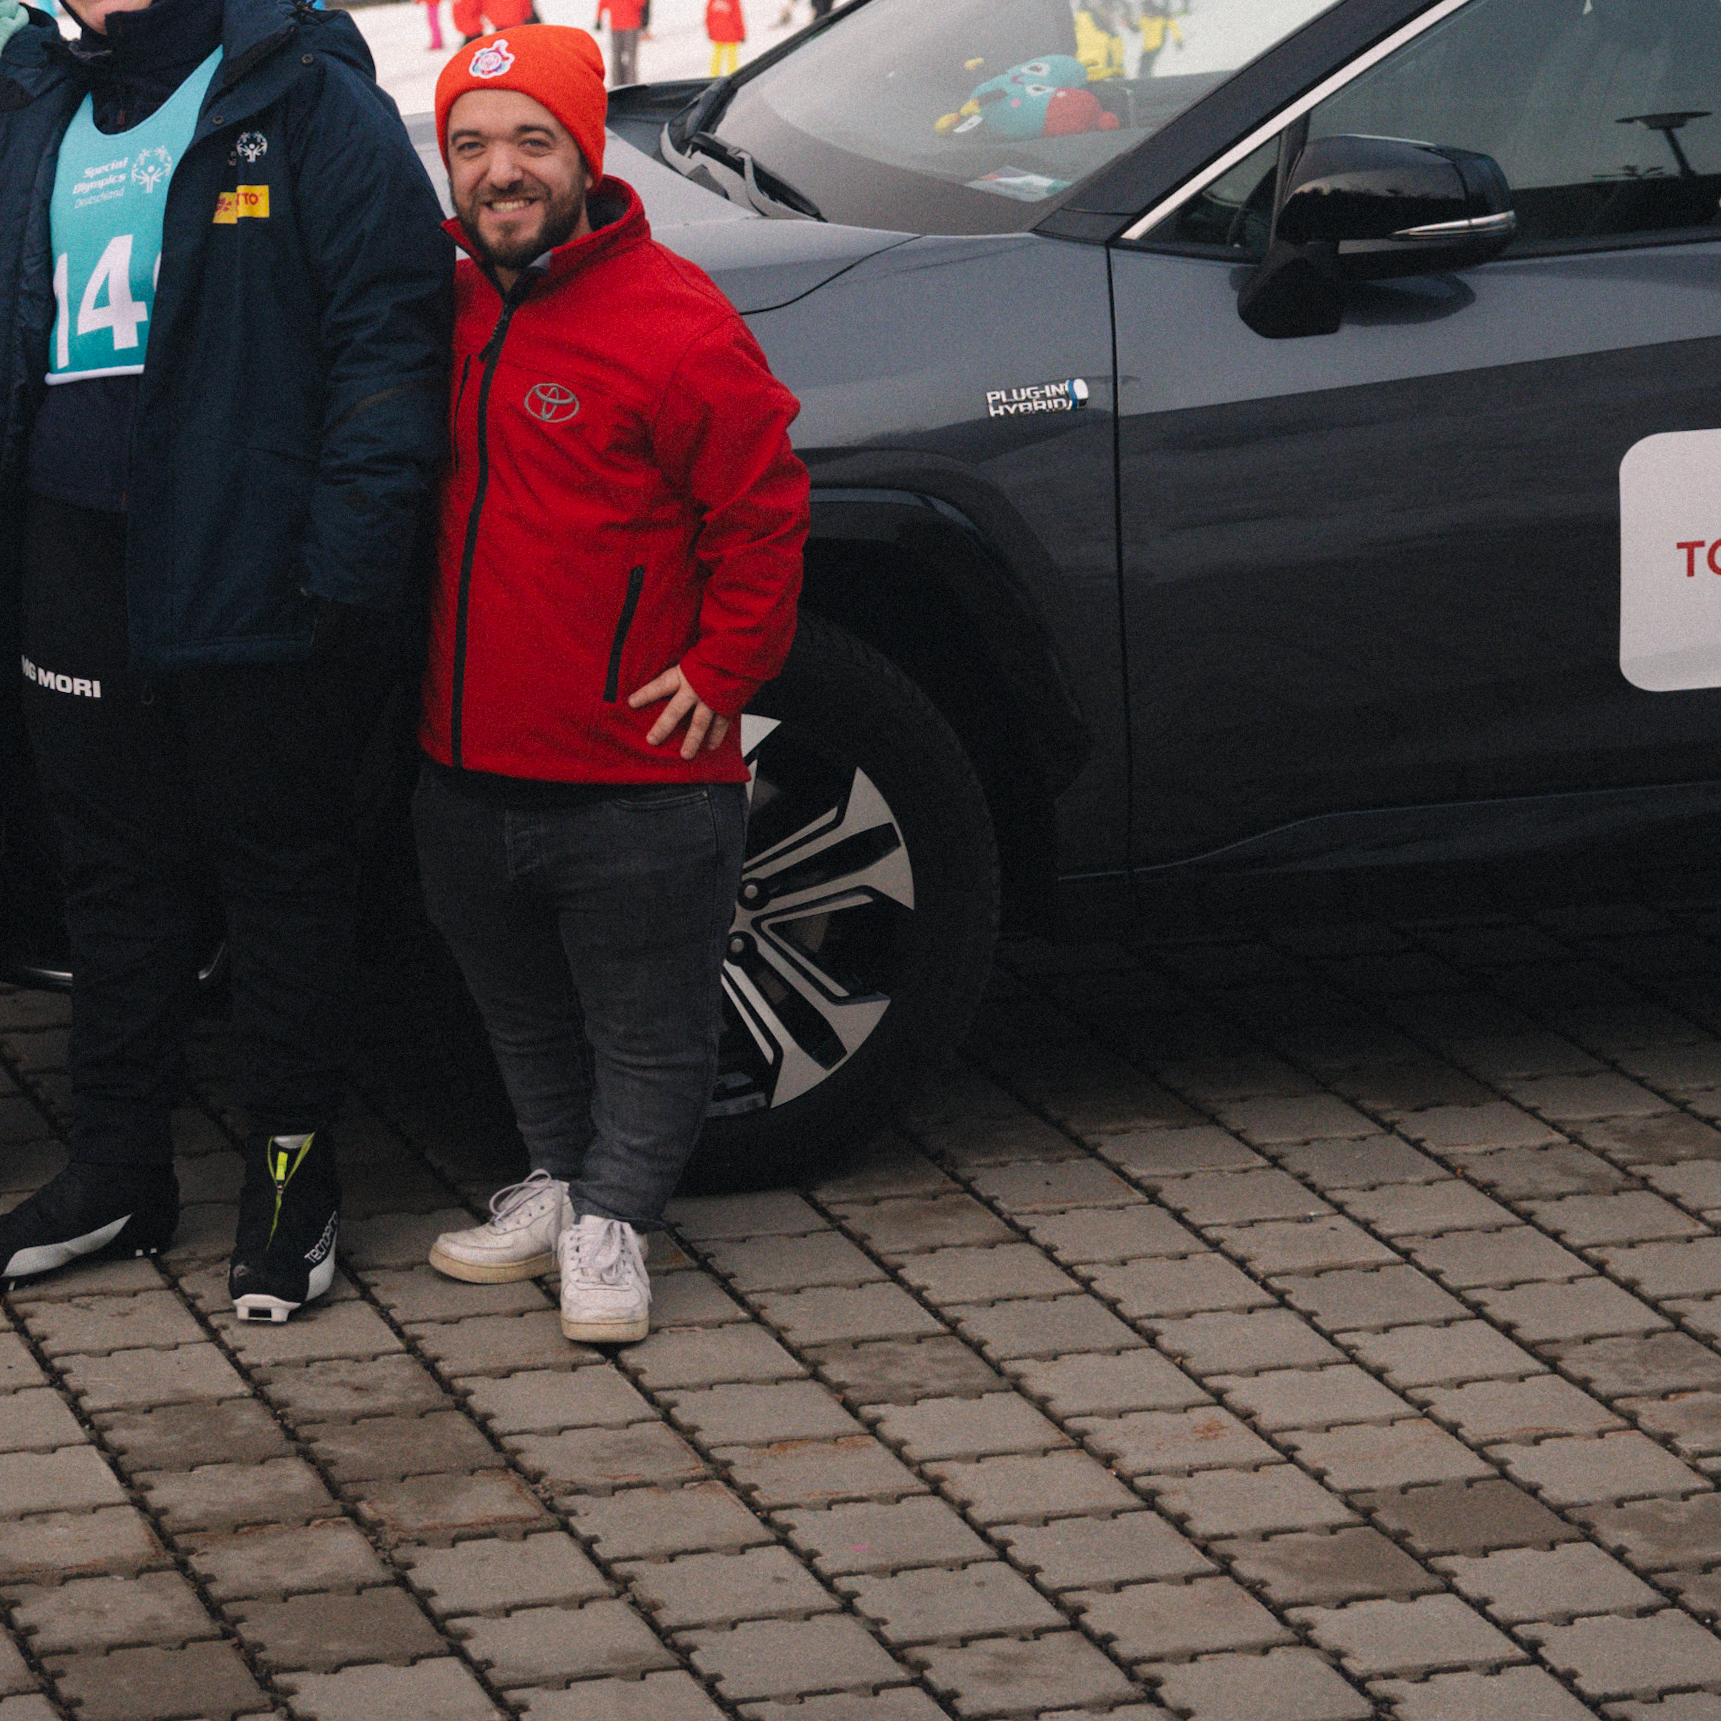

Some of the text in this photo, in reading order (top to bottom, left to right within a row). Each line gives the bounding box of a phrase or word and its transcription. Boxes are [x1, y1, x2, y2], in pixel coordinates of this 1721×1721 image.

[83, 157, 129, 179] Special
[71, 172, 127, 195] Olympics
[986, 381, 1070, 405] PLUG-IN
[988, 397, 1069, 418] HYBRID
[37, 666, 102, 699] MORI
